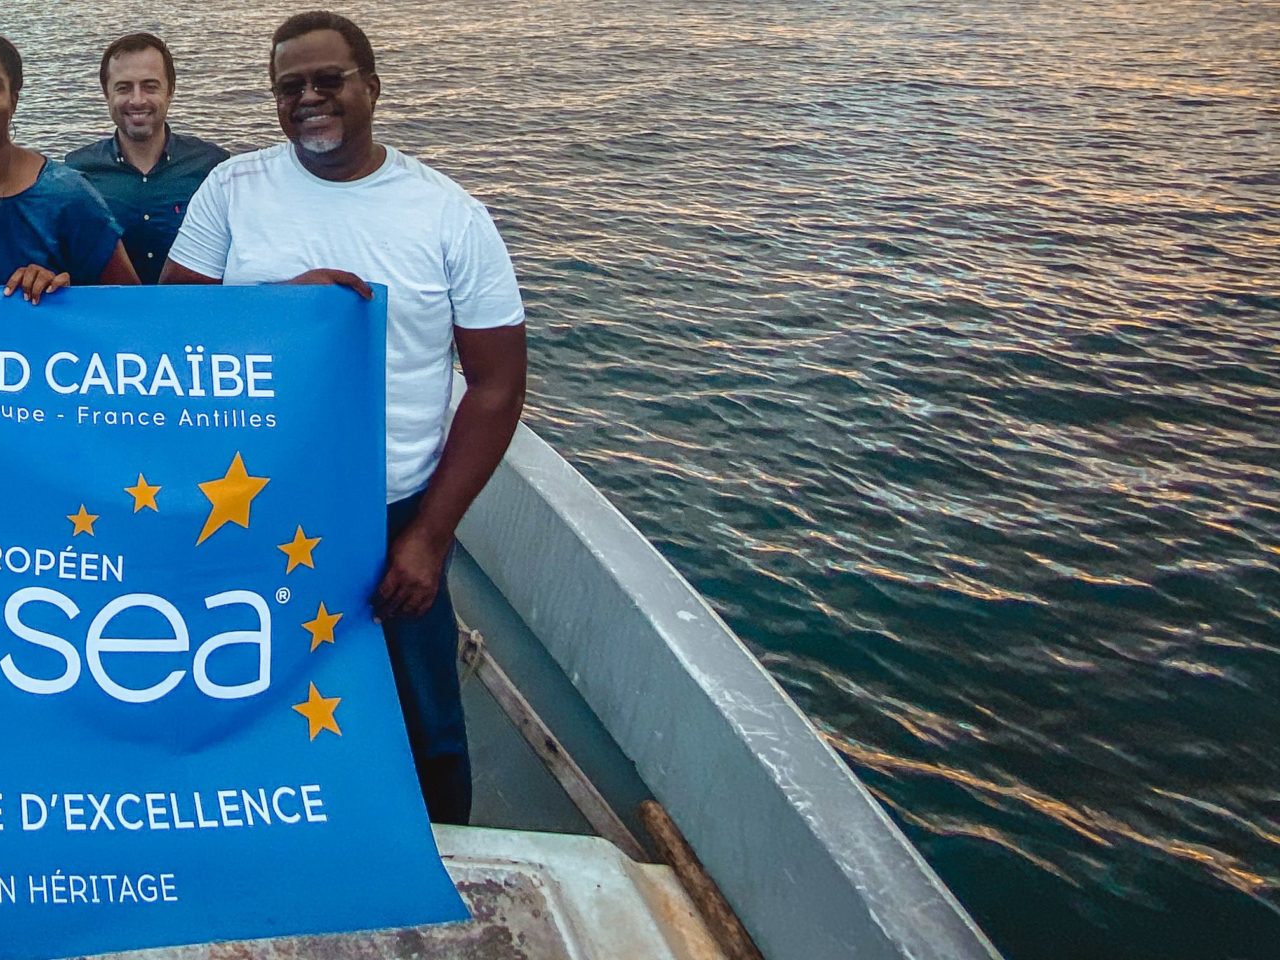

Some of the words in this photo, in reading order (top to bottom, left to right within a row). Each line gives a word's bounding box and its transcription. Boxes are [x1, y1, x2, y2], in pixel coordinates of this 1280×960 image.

[45, 345, 275, 398] CARAÏBE
[78, 406, 165, 426] France
[178, 409, 276, 428] Antilles
[21, 784, 327, 832] D'EXCELLENCE
[28, 868, 178, 903] HÉRITAGE
